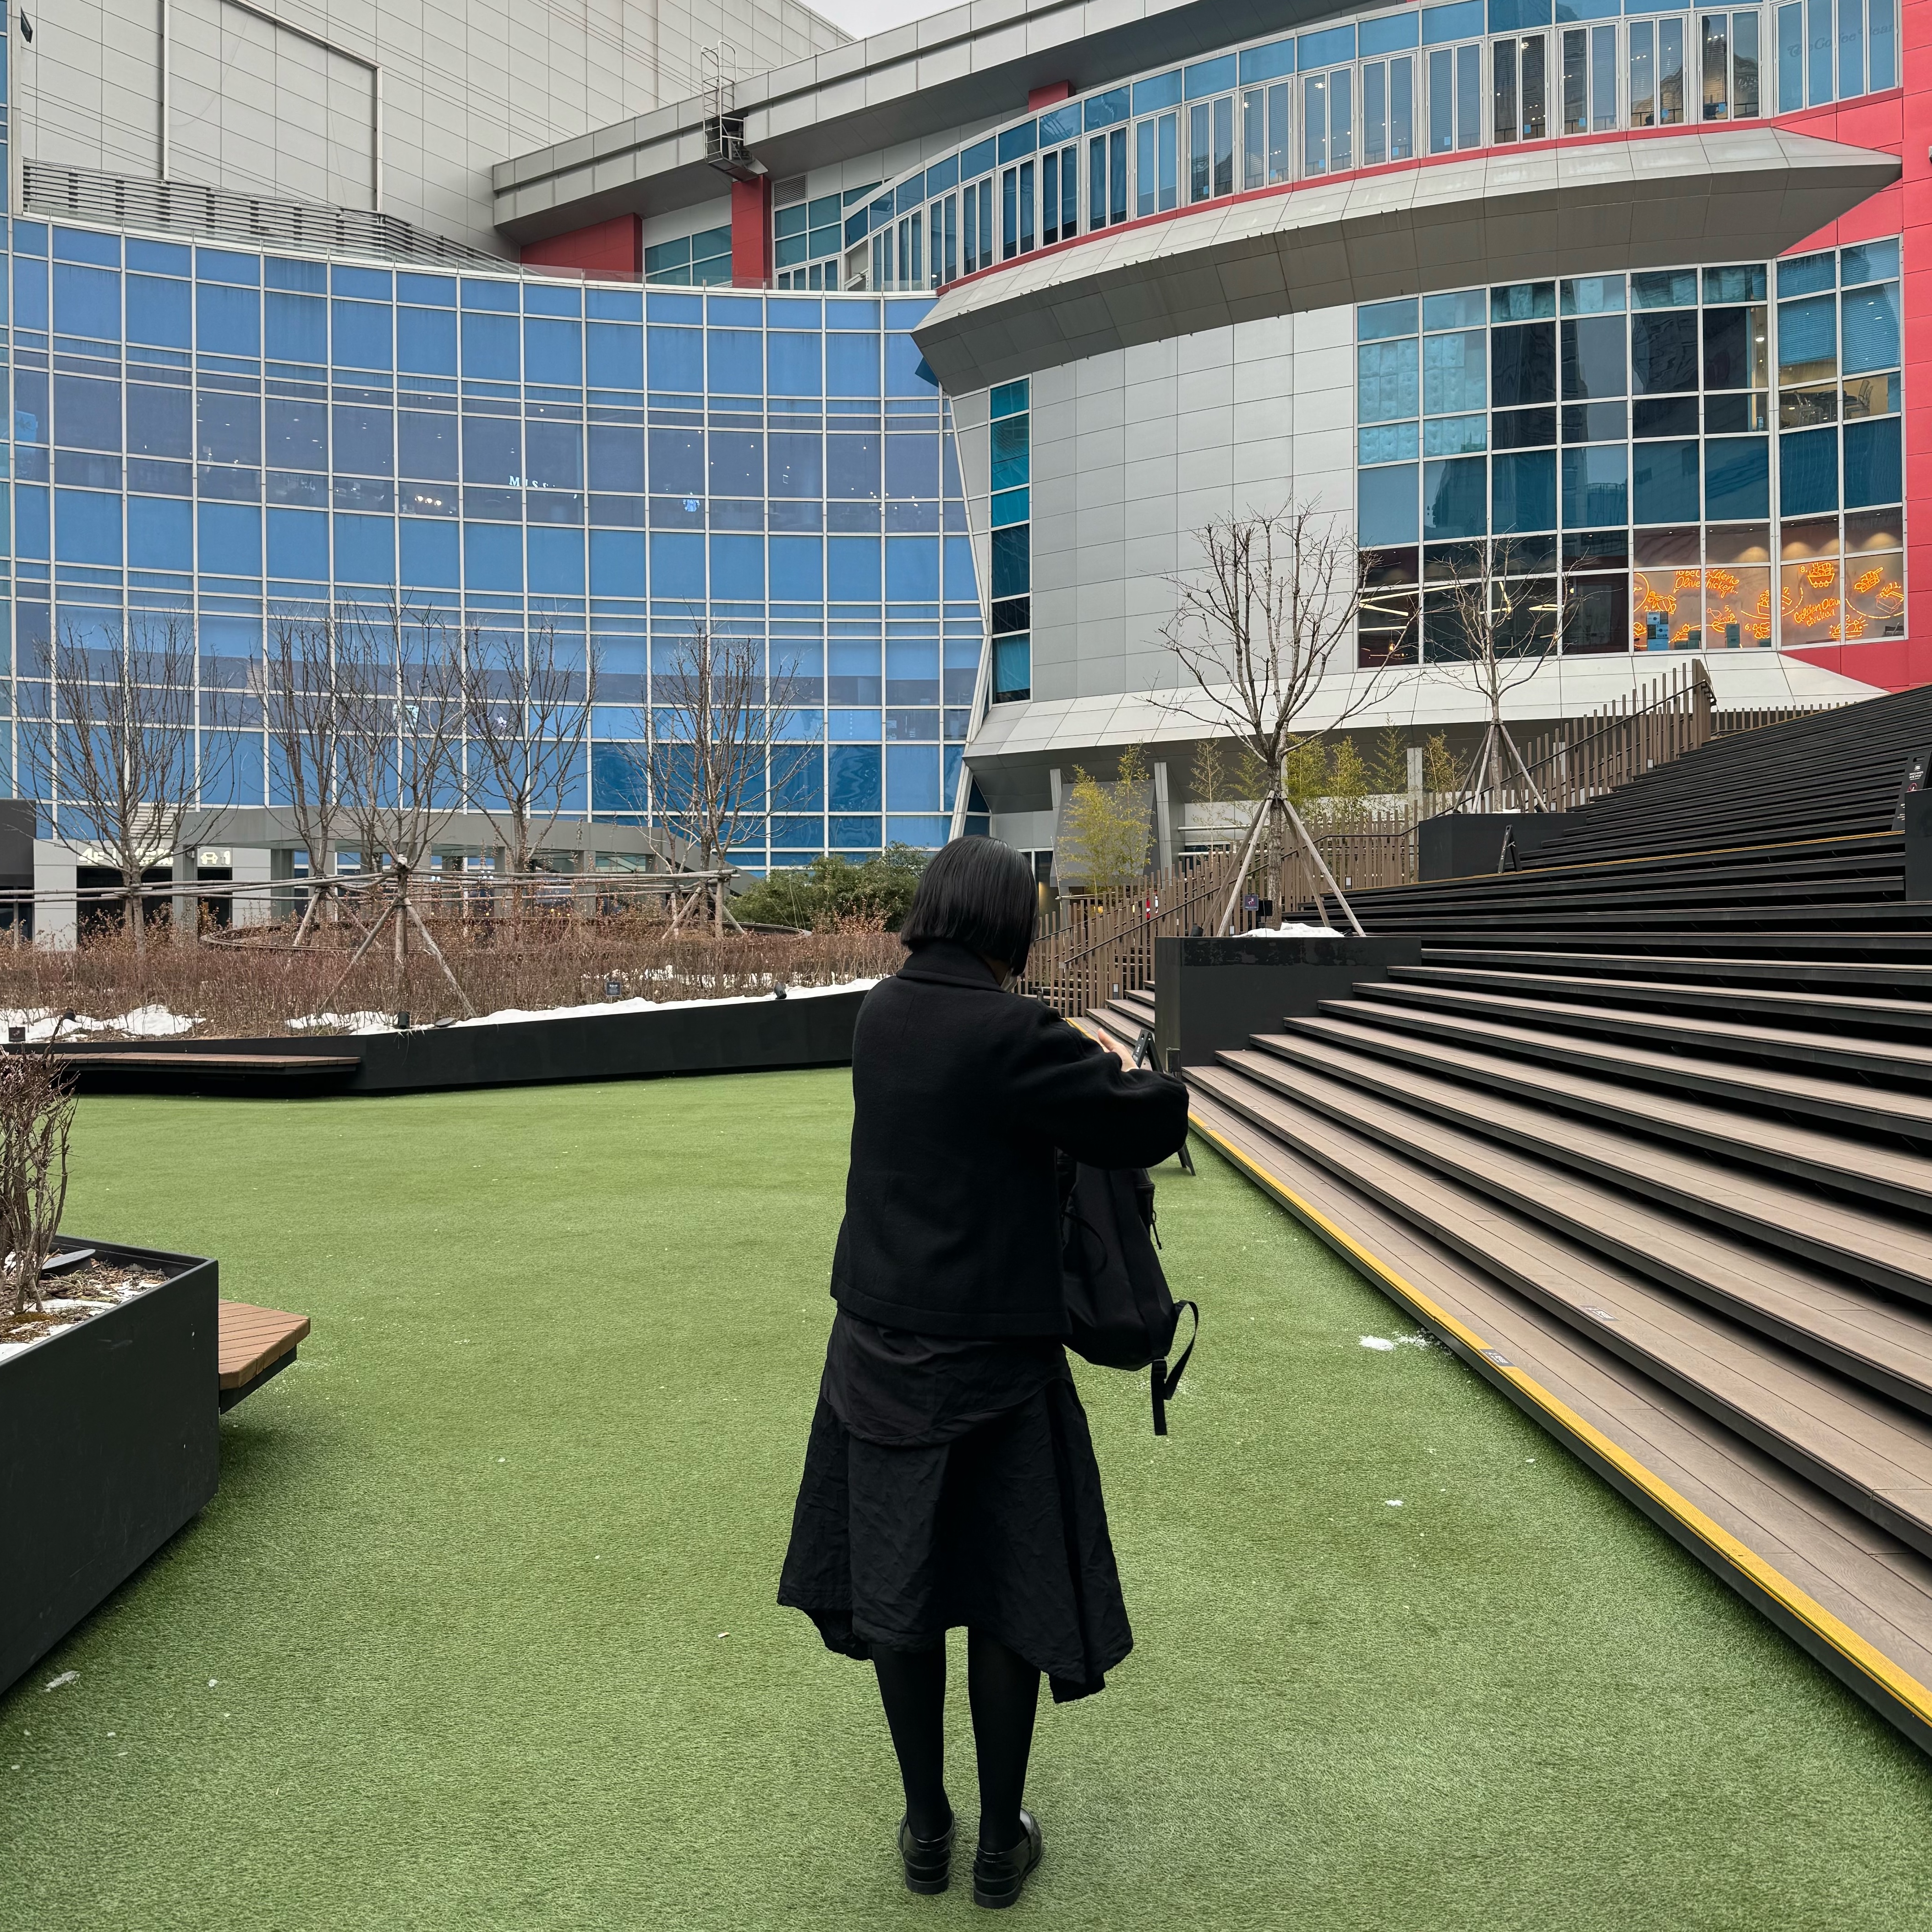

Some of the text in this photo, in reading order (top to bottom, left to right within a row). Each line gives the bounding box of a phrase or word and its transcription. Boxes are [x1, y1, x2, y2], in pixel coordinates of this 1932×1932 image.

[1787, 43, 1813, 57] Te
[1814, 33, 1856, 49] Coee
[1821, 598, 1841, 610] Oliv
